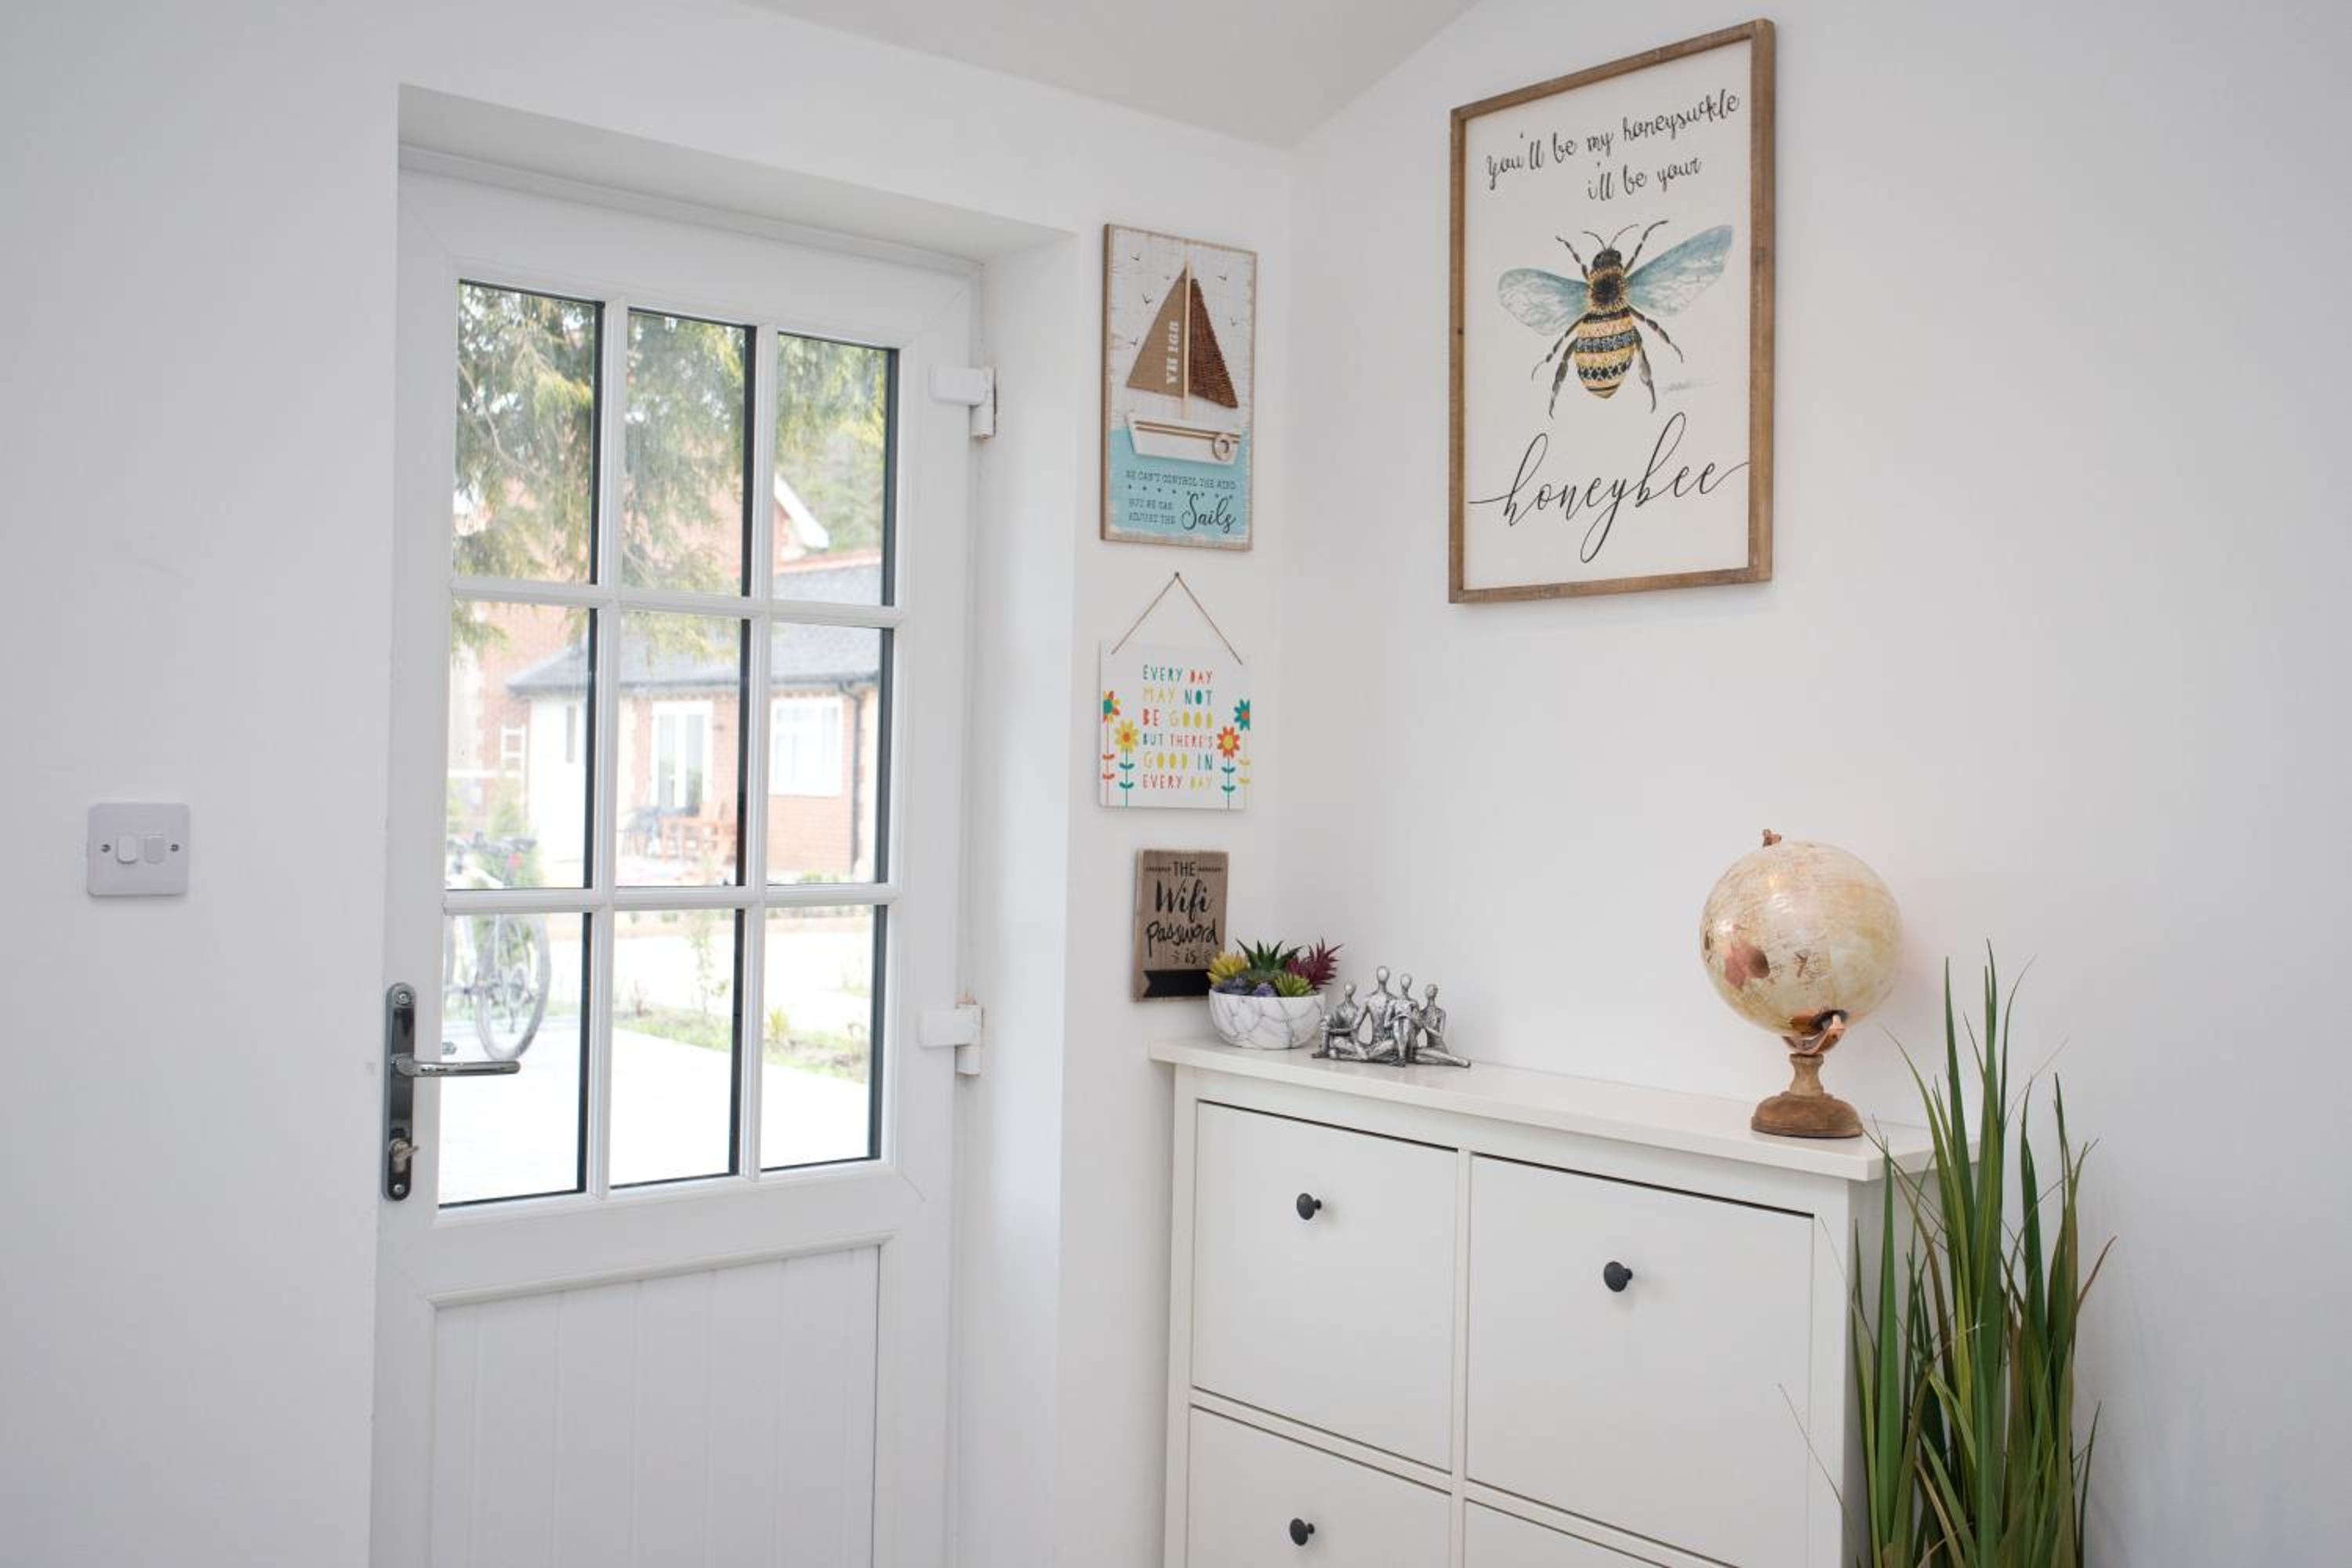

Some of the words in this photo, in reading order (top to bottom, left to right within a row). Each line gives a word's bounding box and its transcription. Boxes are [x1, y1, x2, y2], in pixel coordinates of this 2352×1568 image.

[1486, 130, 1544, 191] you'll
[1552, 132, 1577, 163] be
[1586, 131, 1614, 158] my
[1622, 89, 1740, 140] honeysuckle
[1623, 164, 1646, 194] be
[1657, 157, 1701, 192] your
[1162, 474, 1199, 487] CONTROL
[1200, 477, 1214, 488] THE
[1468, 412, 1749, 563] honeybee
[1181, 493, 1236, 534] Sails
[1142, 665, 1183, 682] EVERY
[1189, 670, 1213, 684] DAY
[1142, 687, 1175, 703] MAY
[1185, 689, 1213, 706] NOT
[1142, 708, 1160, 727] BE
[1169, 710, 1214, 728] GOOD
[1142, 733, 1163, 746] BUT
[1170, 733, 1213, 750] THERE'S
[1143, 750, 1188, 770] GOOD
[1197, 753, 1213, 771] IN
[1142, 773, 1182, 789] EVERY
[1173, 861, 1196, 877] THE
[1156, 879, 1212, 923] Wifi
[1185, 948, 1197, 964] is
